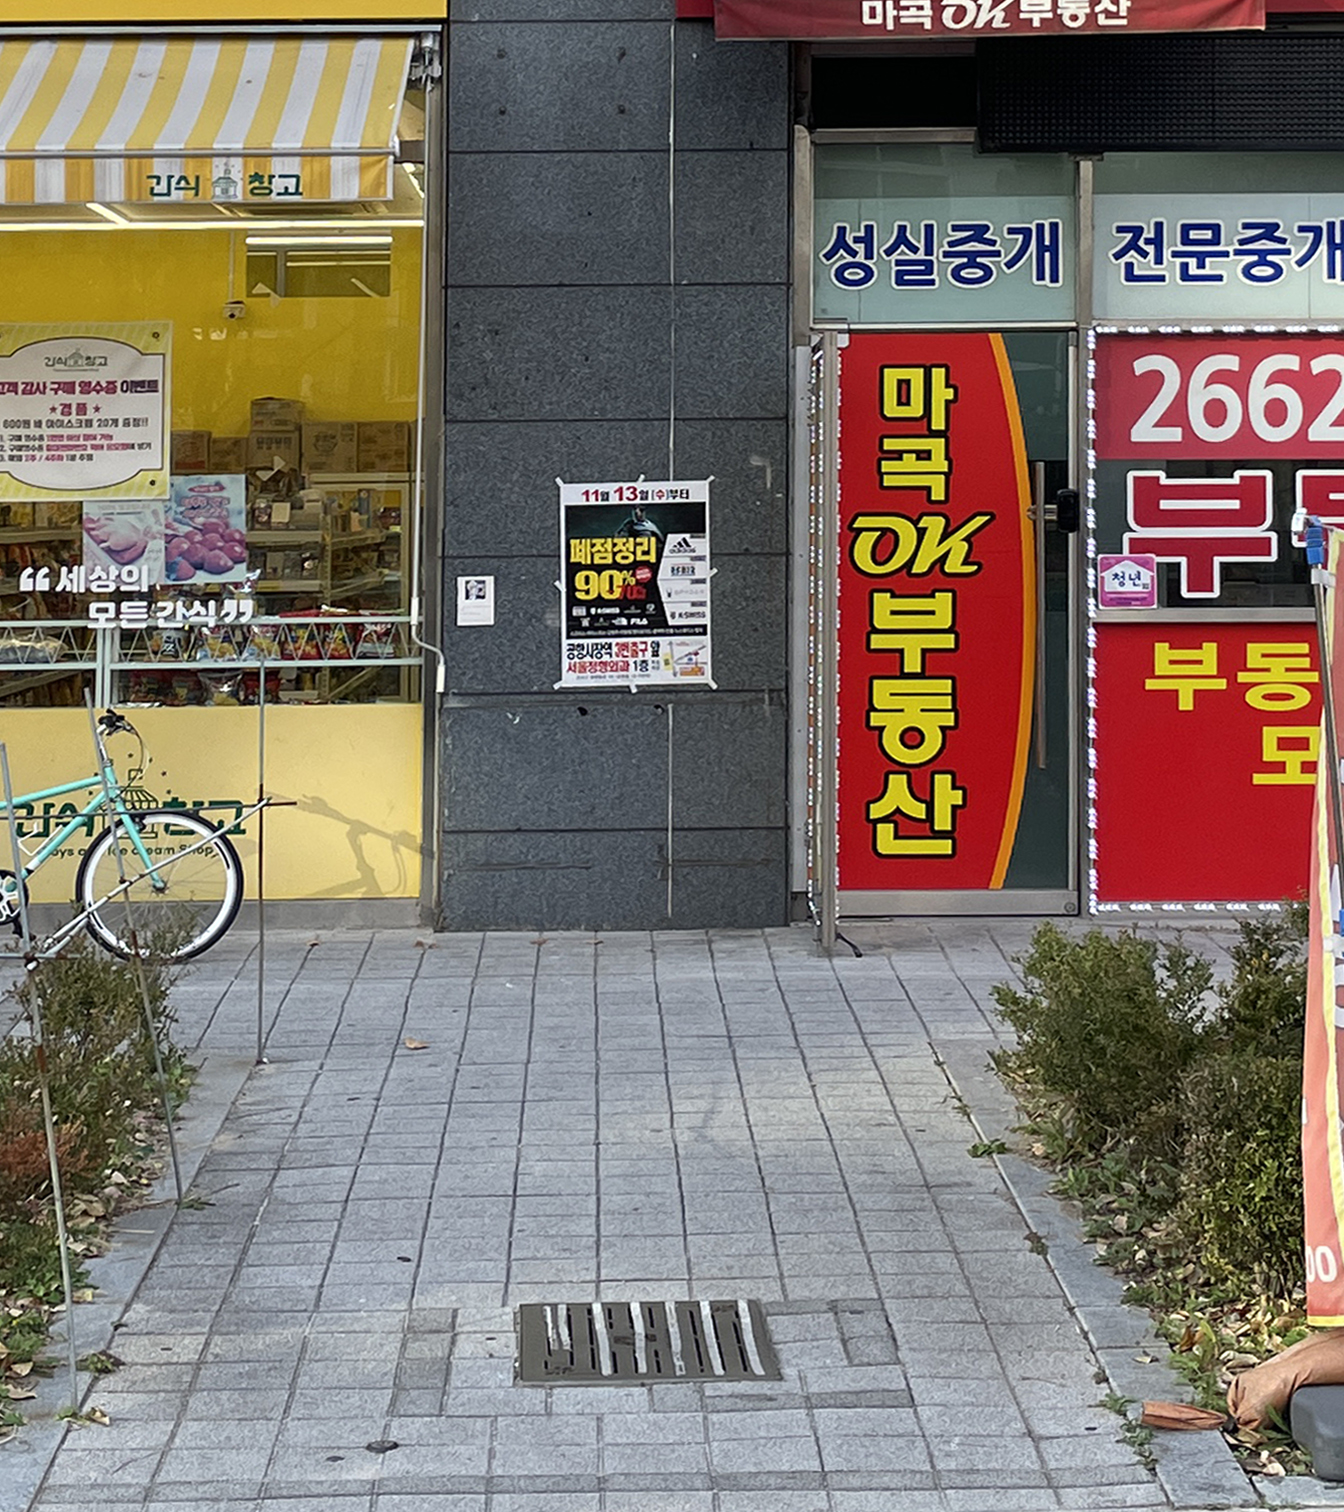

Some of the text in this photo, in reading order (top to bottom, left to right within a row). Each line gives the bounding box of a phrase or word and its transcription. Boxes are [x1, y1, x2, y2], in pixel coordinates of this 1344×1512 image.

[146, 172, 304, 197] 간식 창고
[819, 220, 1064, 290] 성실중개
[570, 536, 657, 565] 폐점정리
[87, 601, 149, 629] 모든
[1144, 641, 1321, 712] 부동
